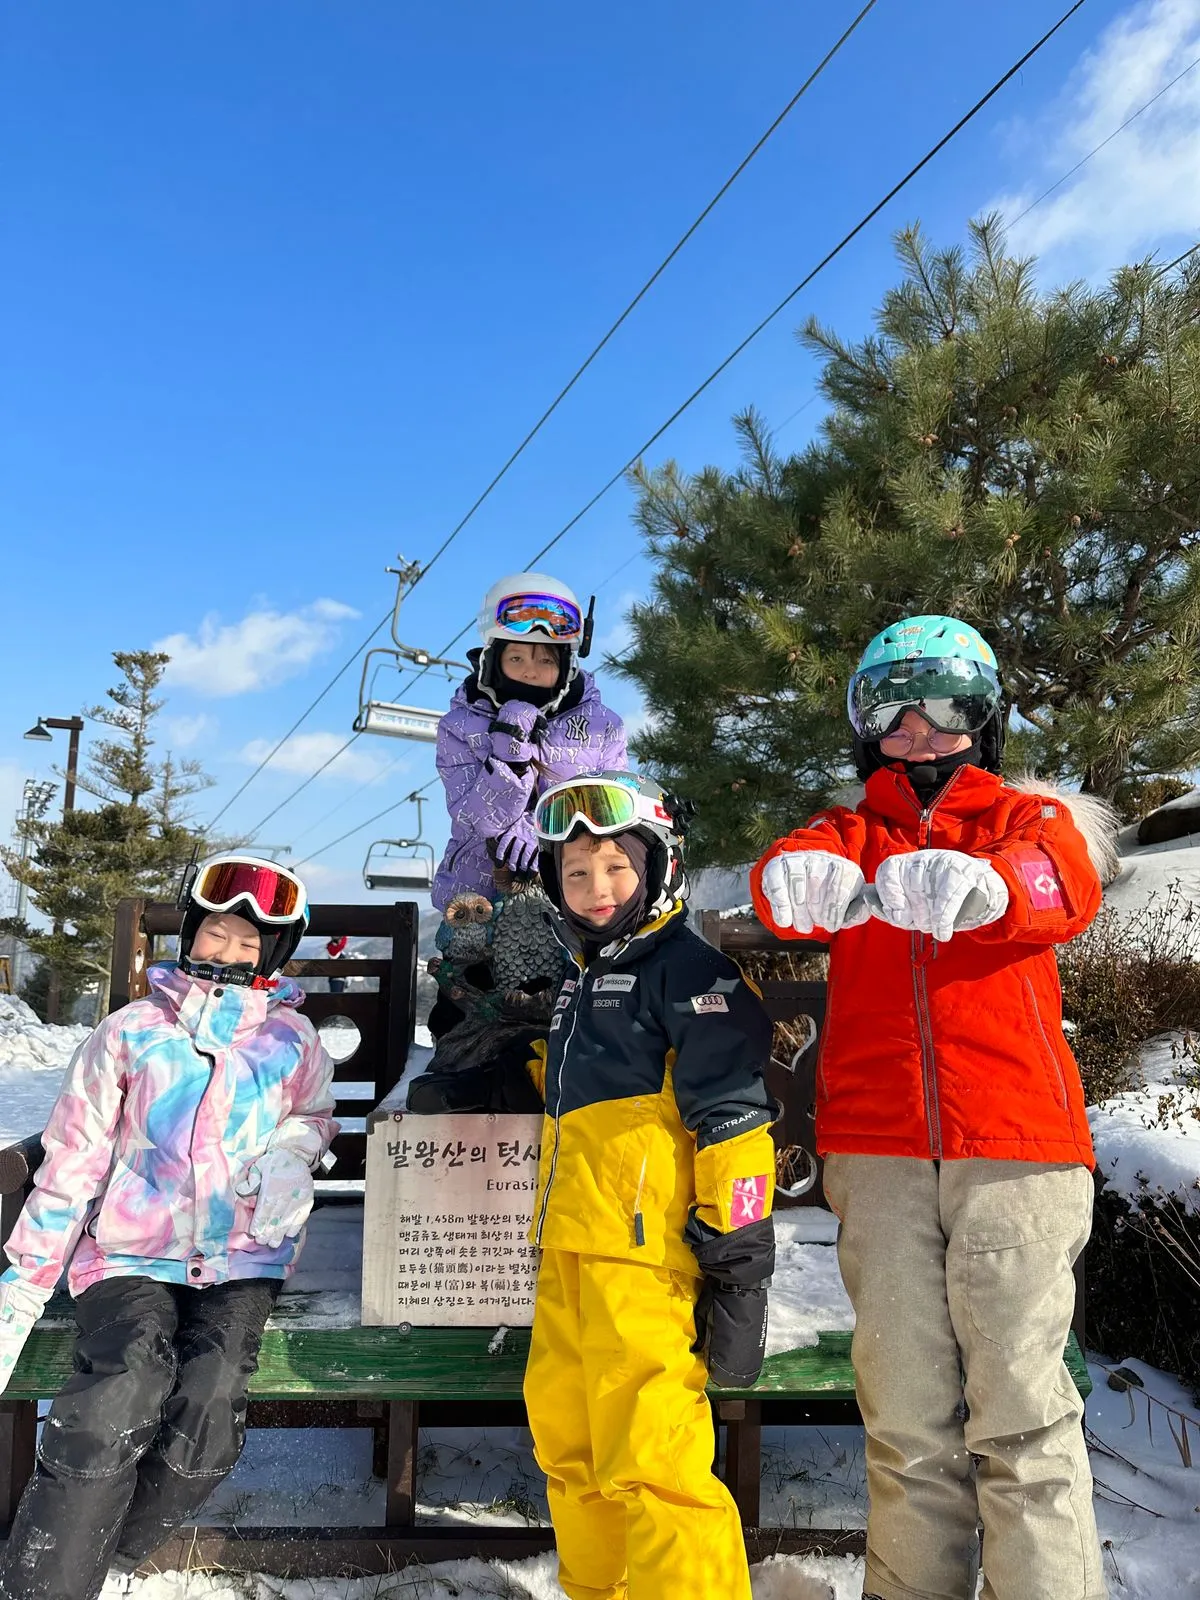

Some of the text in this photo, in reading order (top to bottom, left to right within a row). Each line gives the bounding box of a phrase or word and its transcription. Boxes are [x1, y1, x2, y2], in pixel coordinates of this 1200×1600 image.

[565, 714, 590, 742] NY
[592, 999, 621, 1008] DESCENTE
[387, 1140, 486, 1168] 발왕산의
[486, 1178, 539, 1191] Eurasi
[400, 1214, 422, 1225] 해발
[425, 1214, 464, 1225] 1,458m
[467, 1214, 511, 1225] 발왕산의
[399, 1230, 528, 1241] 맹금류로 생태계 최상위 포
[399, 1247, 420, 1256] 머리
[423, 1247, 456, 1258] 양쪽에
[458, 1247, 478, 1258] 솟은
[481, 1247, 514, 1258] 귀깃과
[397, 1279, 538, 1292] 때문에 부(富)와 복(福)을 상
[397, 1296, 535, 1308] 지혜의 상징으로 여겨집니다.
